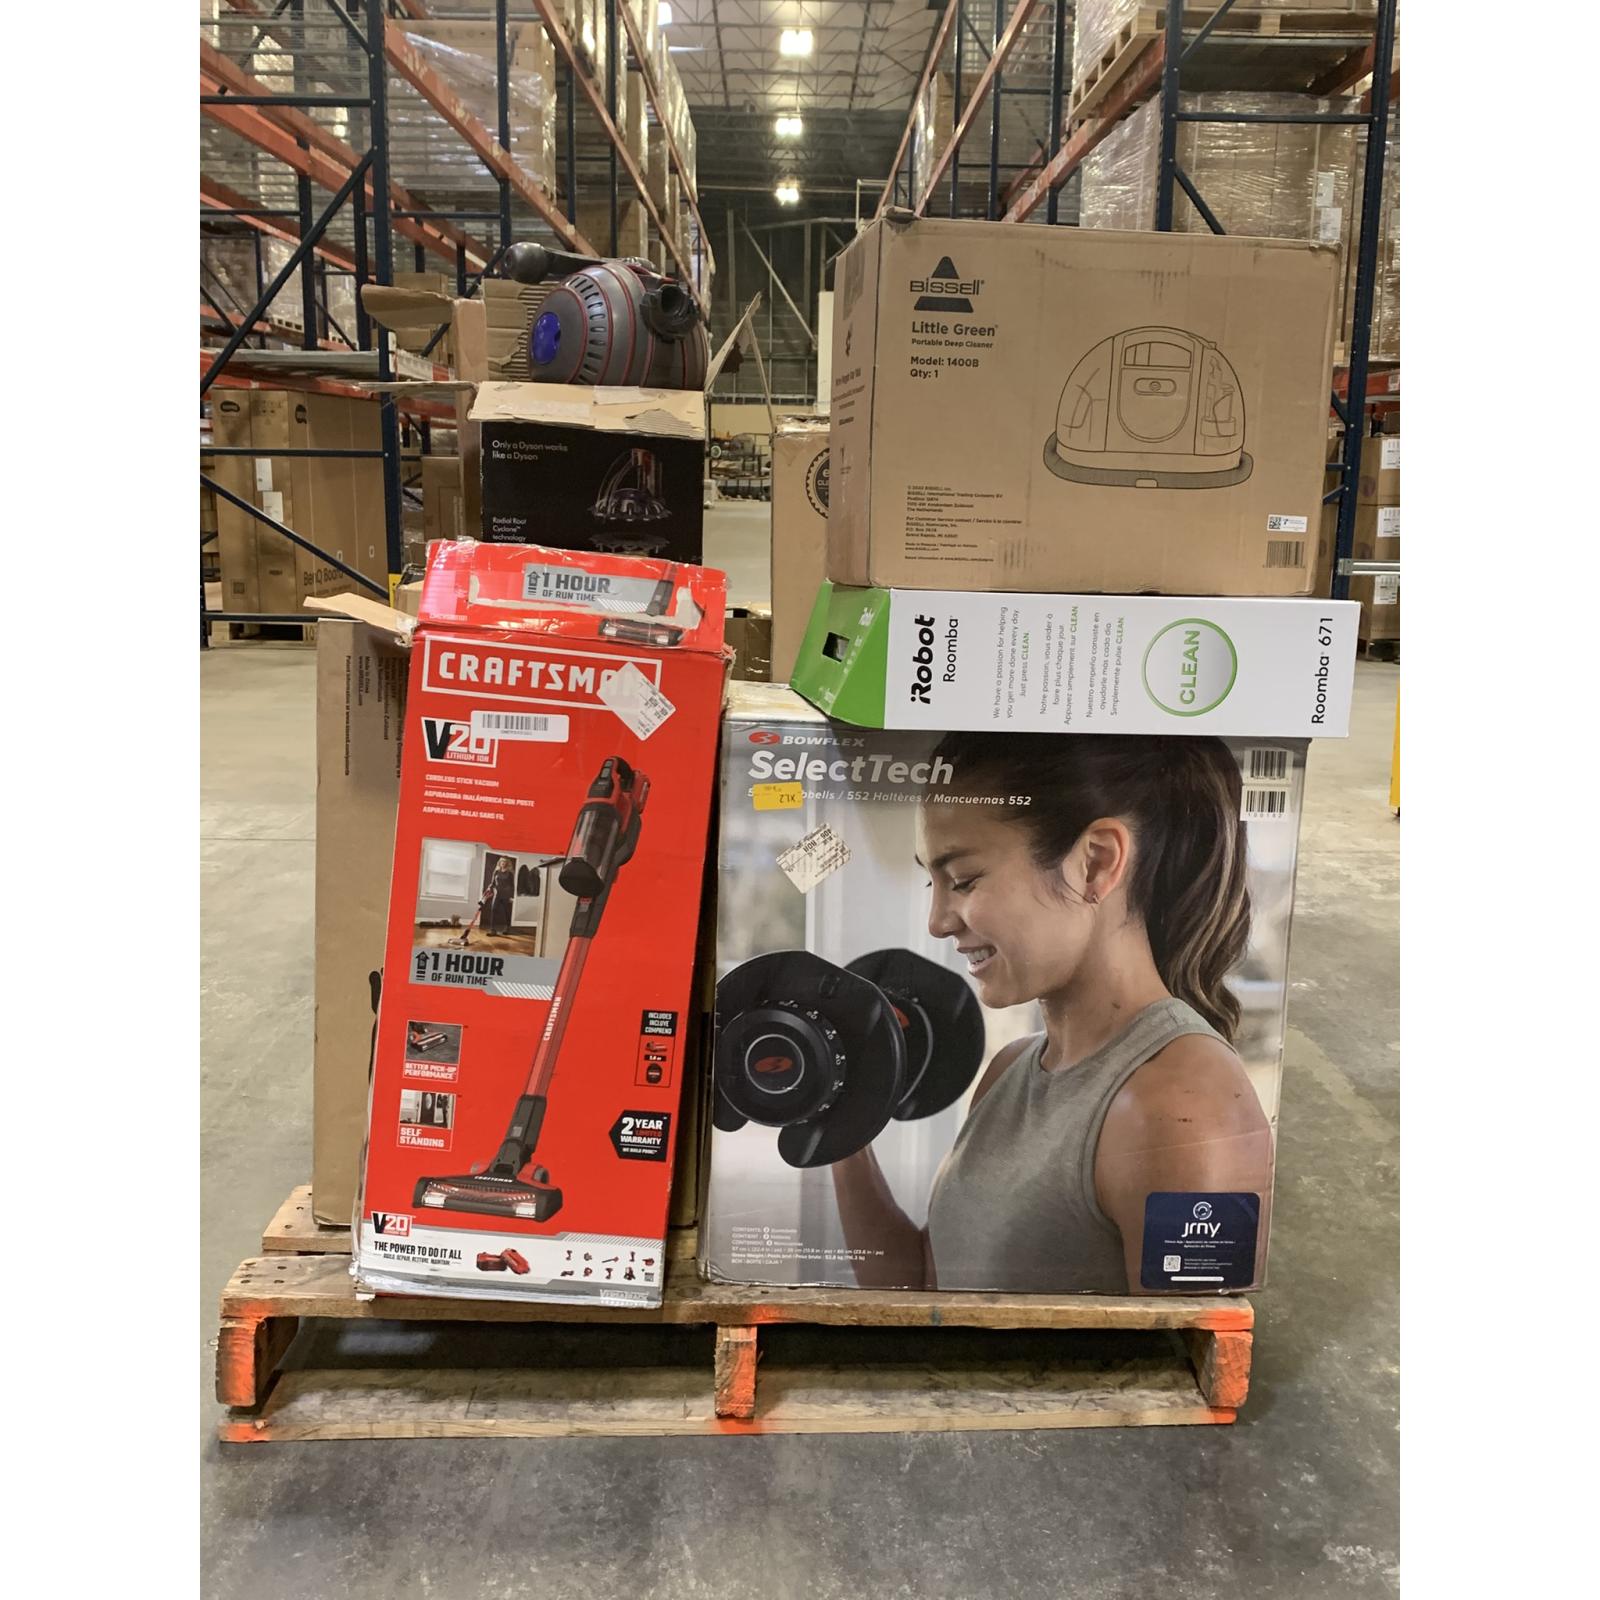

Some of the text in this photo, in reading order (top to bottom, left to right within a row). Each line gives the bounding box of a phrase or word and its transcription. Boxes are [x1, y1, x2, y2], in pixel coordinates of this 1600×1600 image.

[911, 321, 996, 337] Little Green
[911, 338, 993, 349] Portable Deep Cleaner
[909, 356, 979, 368] Model: 1400B
[909, 368, 939, 379] Qty: 1
[492, 440, 511, 450] Only
[519, 441, 543, 452] Dyson
[545, 443, 568, 452] works
[492, 451, 506, 459] like
[513, 452, 538, 461] Dyson
[493, 517, 511, 525] Radial
[493, 534, 526, 542] technology
[542, 572, 610, 594] 1 HOUR
[542, 589, 553, 598] OF
[555, 590, 574, 600] RUN
[998, 606, 1008, 635] helping
[1011, 626, 1019, 647] every
[943, 618, 959, 682] Roomba
[1057, 641, 1065, 668] chaque
[910, 614, 935, 704] iRobot
[996, 649, 1004, 679] passion
[1086, 688, 1095, 718] Nuestro
[1094, 612, 1100, 623] en
[439, 651, 622, 695] CRAFTSMA
[1067, 647, 1075, 692] simplement
[1180, 630, 1200, 705] CLEAN
[1311, 617, 1333, 724] Roomba 671
[993, 689, 1001, 706] have
[1110, 667, 1121, 716] Simplemente
[993, 707, 1000, 719] We
[1064, 692, 1072, 726] Appuyez
[424, 719, 491, 760] V20
[782, 735, 865, 748] BOWFLEX
[446, 752, 489, 763] LITHIUM ION
[748, 750, 954, 785] SelectTech
[425, 774, 499, 787] CORDLESS STICK VACUUM
[424, 790, 462, 800] ASPIRADORA
[503, 796, 516, 806] CON
[516, 798, 535, 808] POSTE
[847, 790, 869, 801] 552
[873, 791, 922, 803] Haltères
[934, 793, 1005, 806] Mancuernas
[1008, 795, 1032, 806] 552
[422, 806, 504, 821] ASPIRATEUR-BALAI SANS FIL
[431, 952, 505, 977] 1 HOUR
[431, 972, 443, 982] OF
[445, 973, 465, 984] RUN
[543, 996, 562, 1041] CRAFTSMAN
[648, 1012, 672, 1020] INCLUDES
[649, 1019, 670, 1027] INCLUYE
[644, 1026, 672, 1034] COMPREND
[404, 1069, 454, 1080] PERFORMANCE
[405, 1062, 457, 1073] BETTER PICK-UP
[400, 1127, 422, 1136] SELF
[621, 1117, 663, 1136] 2 YEAR
[636, 1129, 662, 1137] LIMITED
[399, 1136, 445, 1148] STANDING
[620, 1135, 662, 1146] WARRANTY
[372, 1212, 408, 1234] V20
[1181, 1222, 1221, 1238] jrny
[374, 1241, 462, 1260] THE POWER TO DO IT ALL
